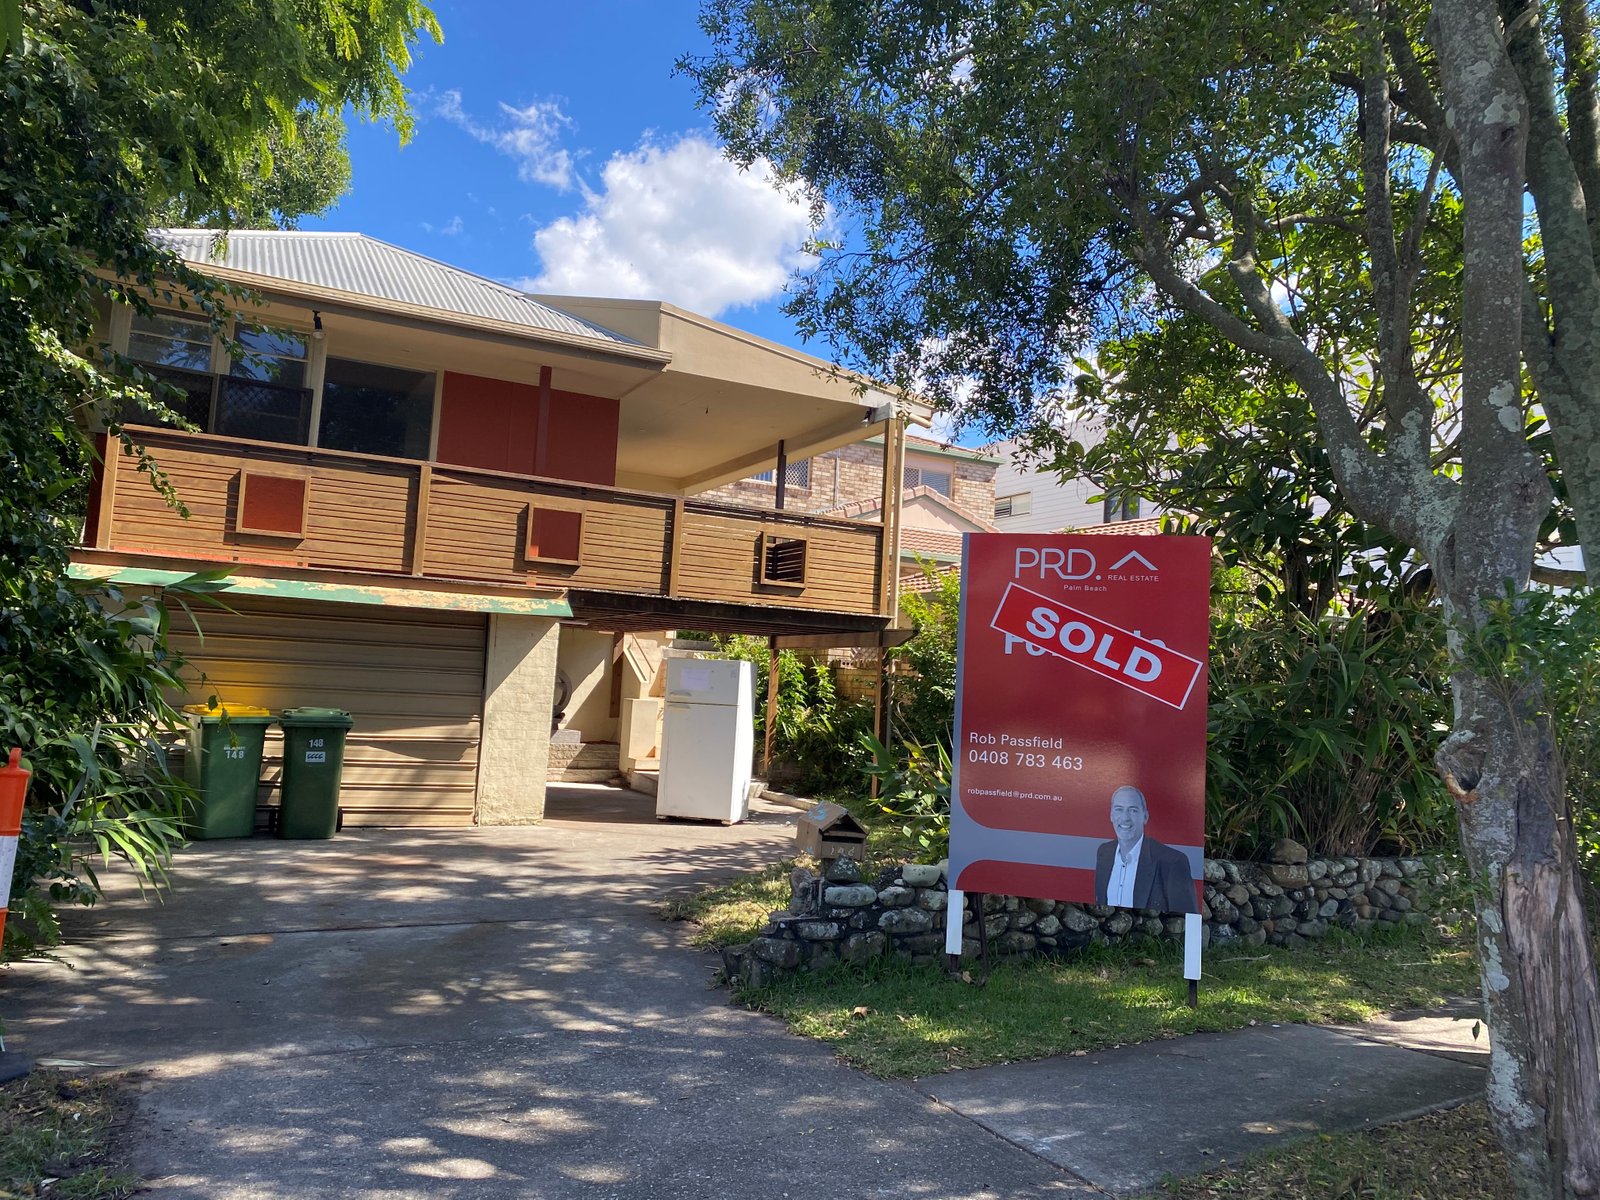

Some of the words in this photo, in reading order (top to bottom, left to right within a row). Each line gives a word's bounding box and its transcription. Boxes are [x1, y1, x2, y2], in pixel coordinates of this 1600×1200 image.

[1063, 584, 1081, 592] Palm
[1026, 607, 1162, 682] SOLD
[308, 738, 324, 748] 148
[969, 732, 996, 744] Rob
[1001, 734, 1063, 748] Passfield
[225, 750, 245, 759] 148
[969, 749, 1009, 765] 0408
[1016, 752, 1045, 768] 783
[1051, 755, 1083, 771] 463
[967, 788, 1063, 801] robpassfield@prd.com.au
